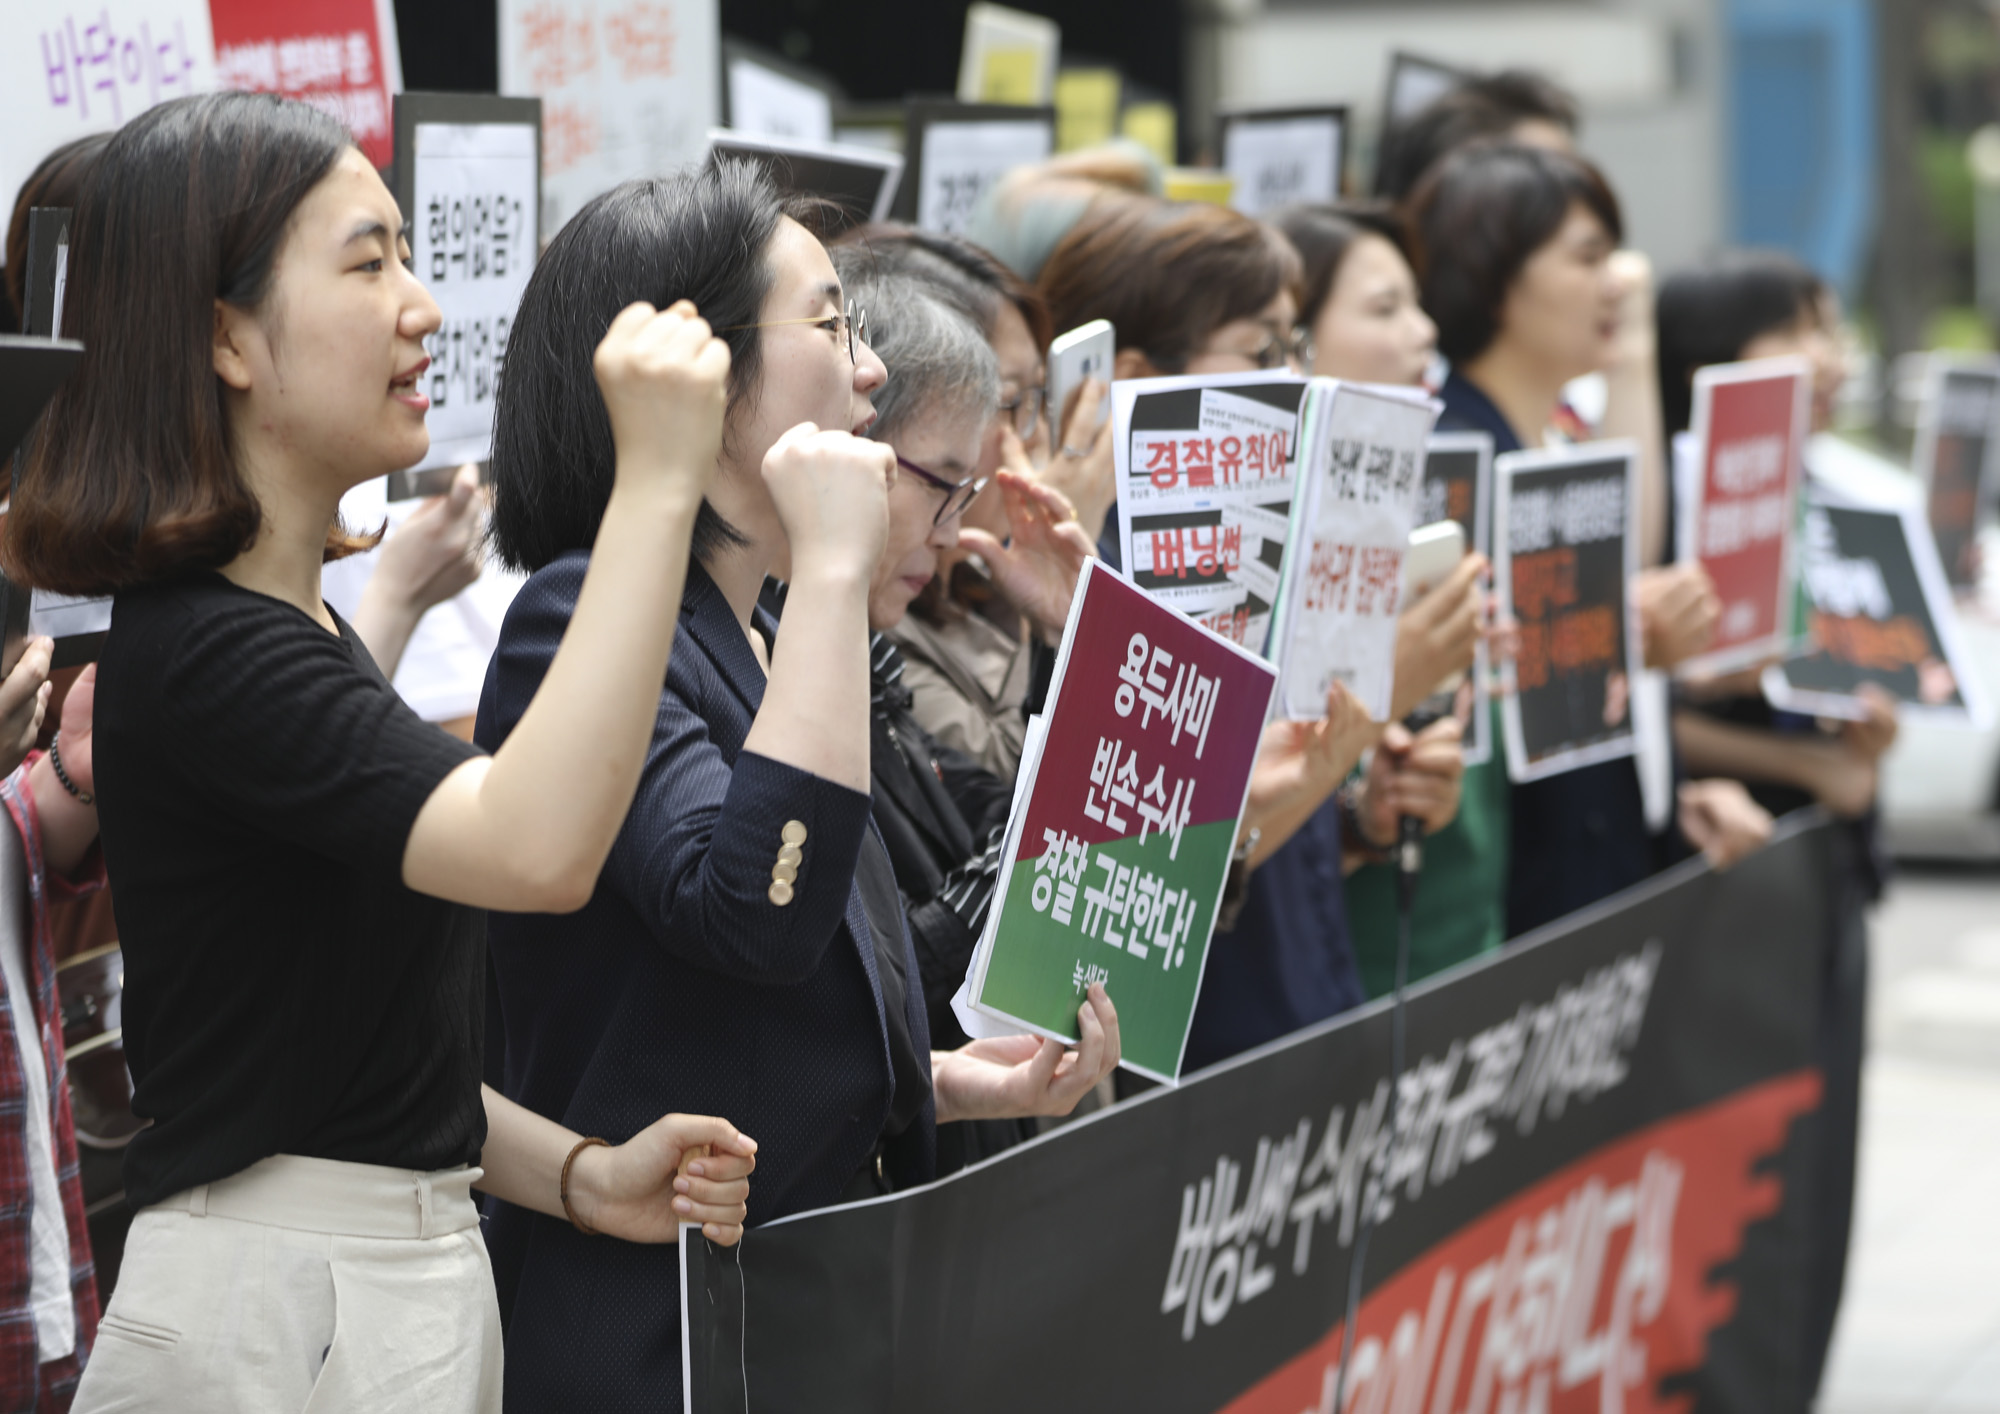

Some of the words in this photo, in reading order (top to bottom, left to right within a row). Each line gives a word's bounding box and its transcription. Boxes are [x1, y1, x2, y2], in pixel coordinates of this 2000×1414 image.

[1151, 524, 1242, 579] 버닝썬
[1114, 632, 1221, 761] 용두사미
[1083, 736, 1139, 835] 빈손
[1136, 764, 1197, 861] 수사
[1031, 827, 1089, 928] 경찰
[1081, 852, 1198, 972] 규탄한다!
